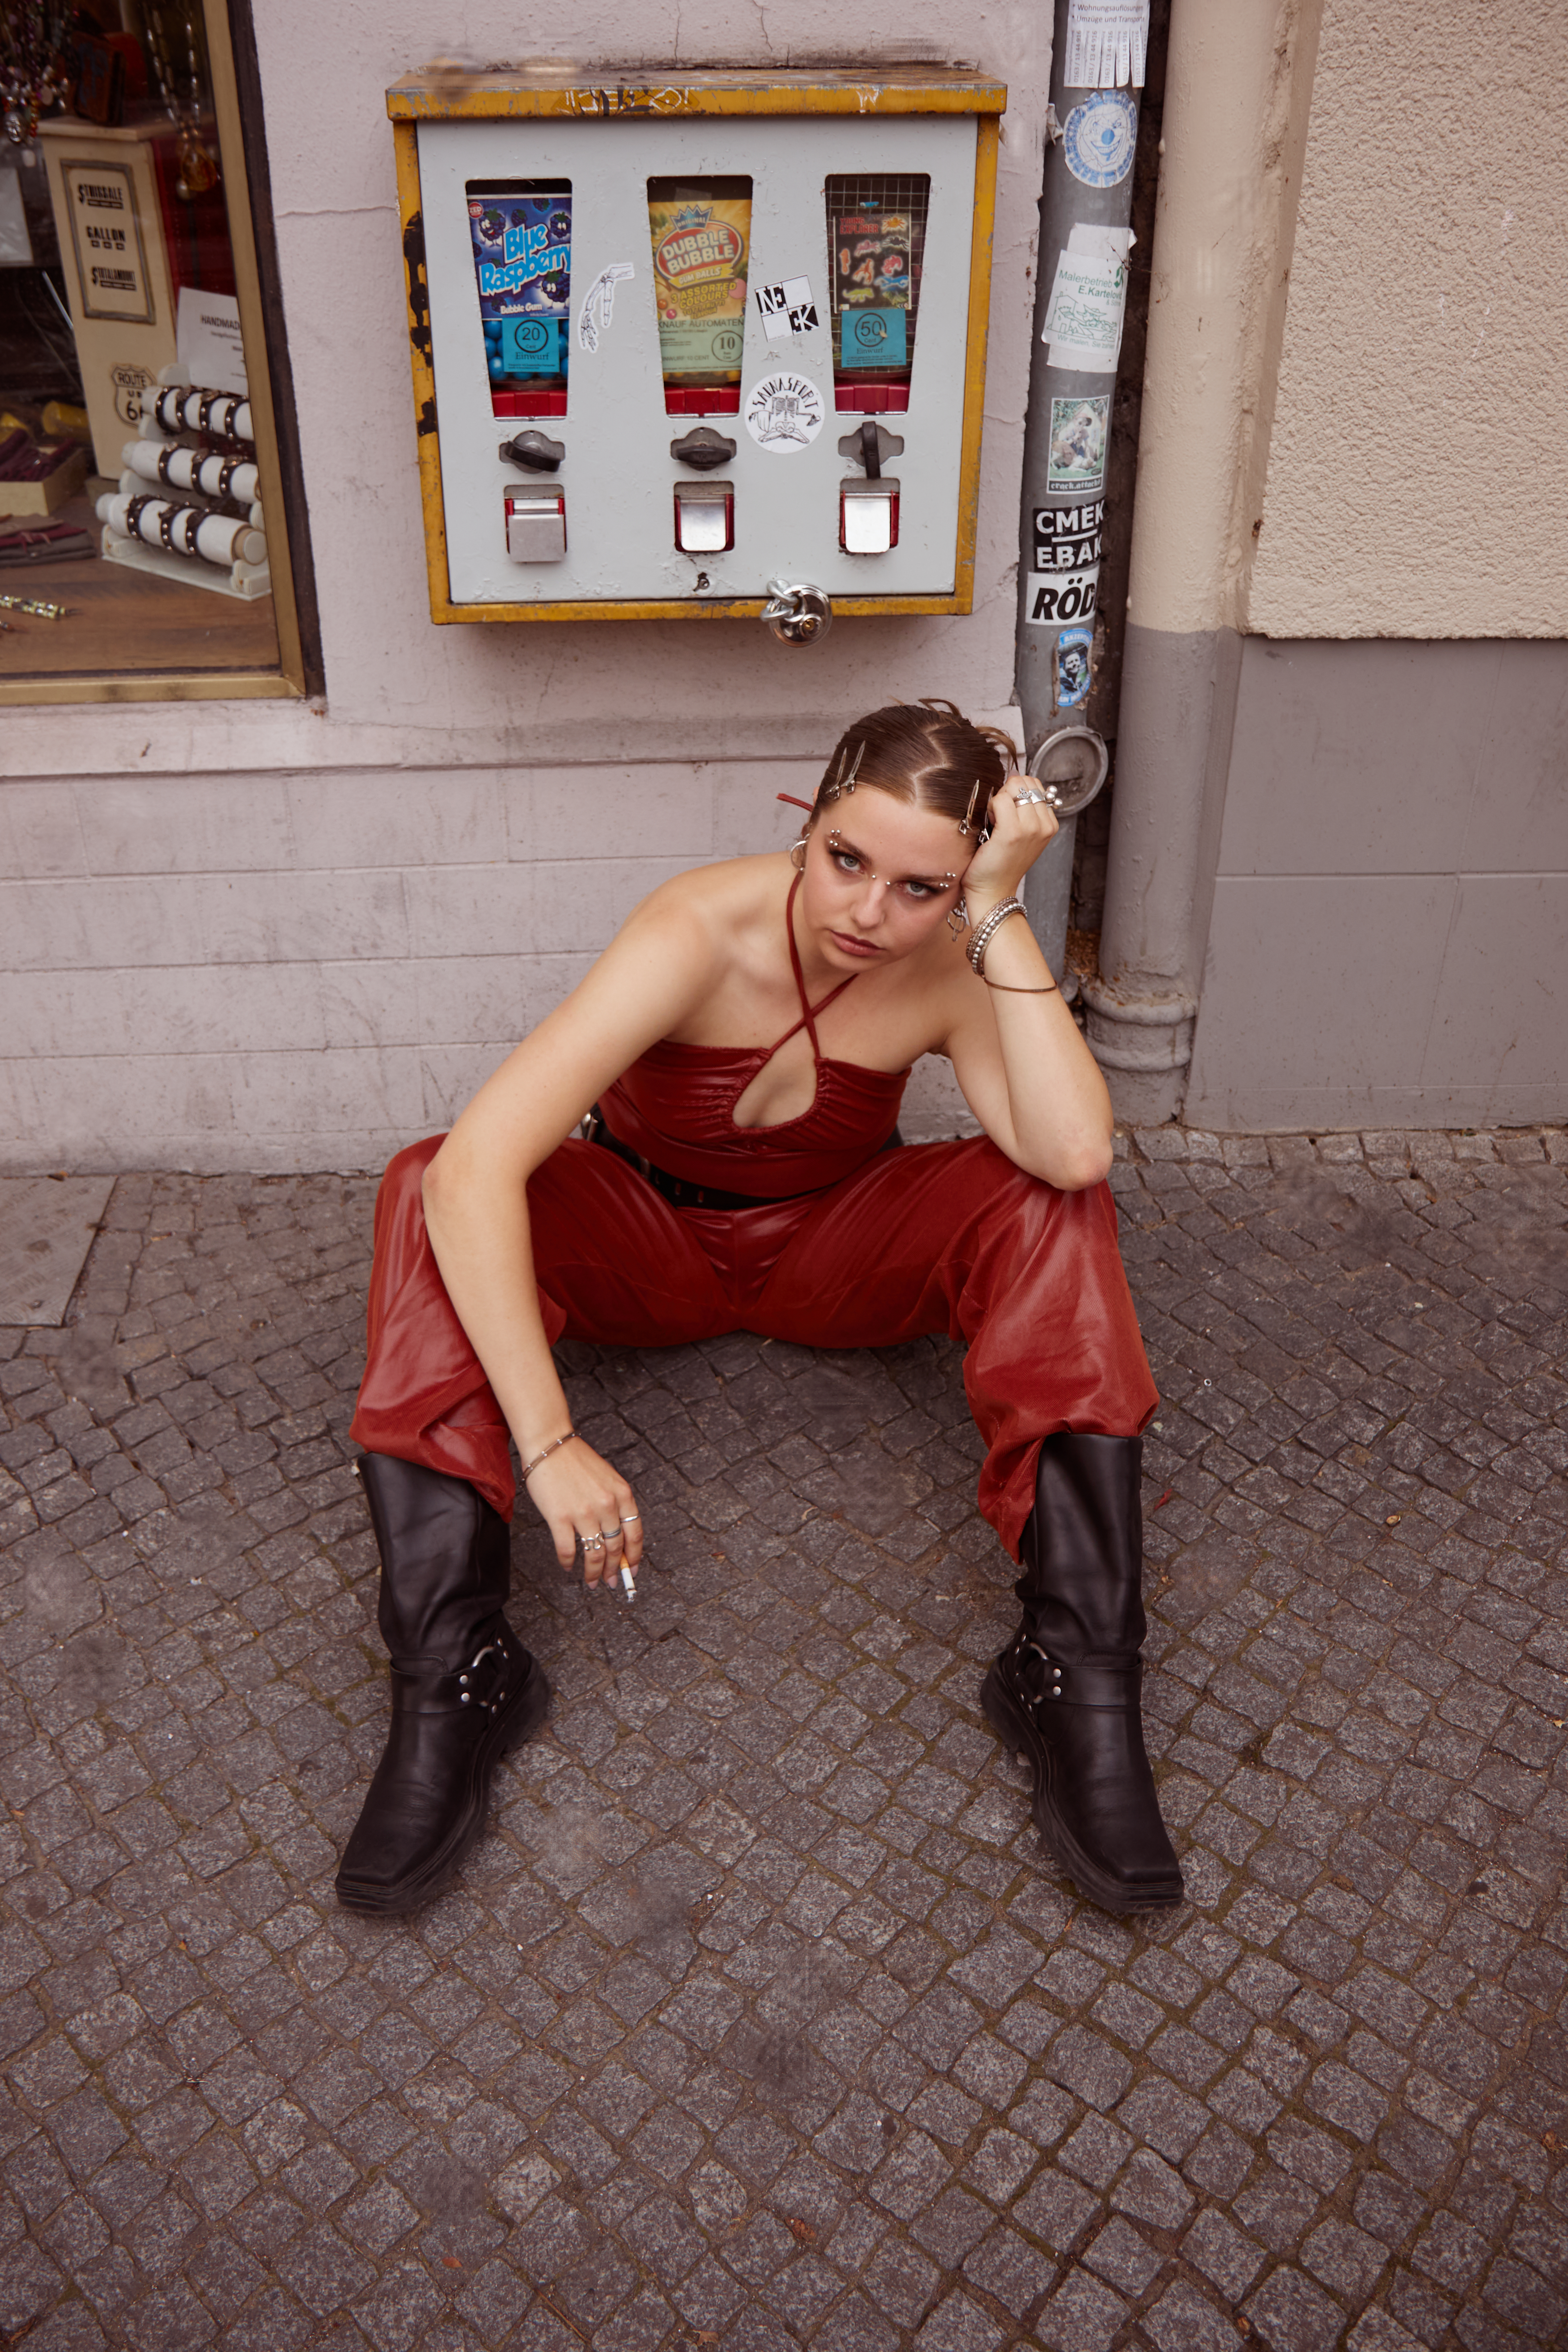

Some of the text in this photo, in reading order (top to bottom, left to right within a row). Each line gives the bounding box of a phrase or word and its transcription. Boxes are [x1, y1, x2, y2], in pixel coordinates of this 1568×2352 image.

[678, 217, 705, 227] ORIGINAL
[839, 217, 865, 225] YOUNG
[840, 224, 879, 234] EXPLORER
[87, 225, 126, 241] GALLON
[503, 223, 549, 264] Blue
[662, 229, 729, 260] DUBBLE
[667, 244, 734, 275] BUBBLE
[479, 243, 571, 296] Raspberry
[678, 267, 721, 284] GUM BALLS
[1059, 270, 1112, 288] Malerbetrieb
[671, 282, 736, 304] 3 ASSORTED
[680, 290, 729, 309] COLOURS
[500, 302, 542, 315] Bubble Gum
[690, 319, 744, 327] AUTOMATEN
[861, 321, 881, 336] 50
[522, 328, 540, 340] 20
[720, 337, 735, 349] 10
[118, 372, 146, 388] ROUTE
[1032, 577, 1095, 620] RÖD
